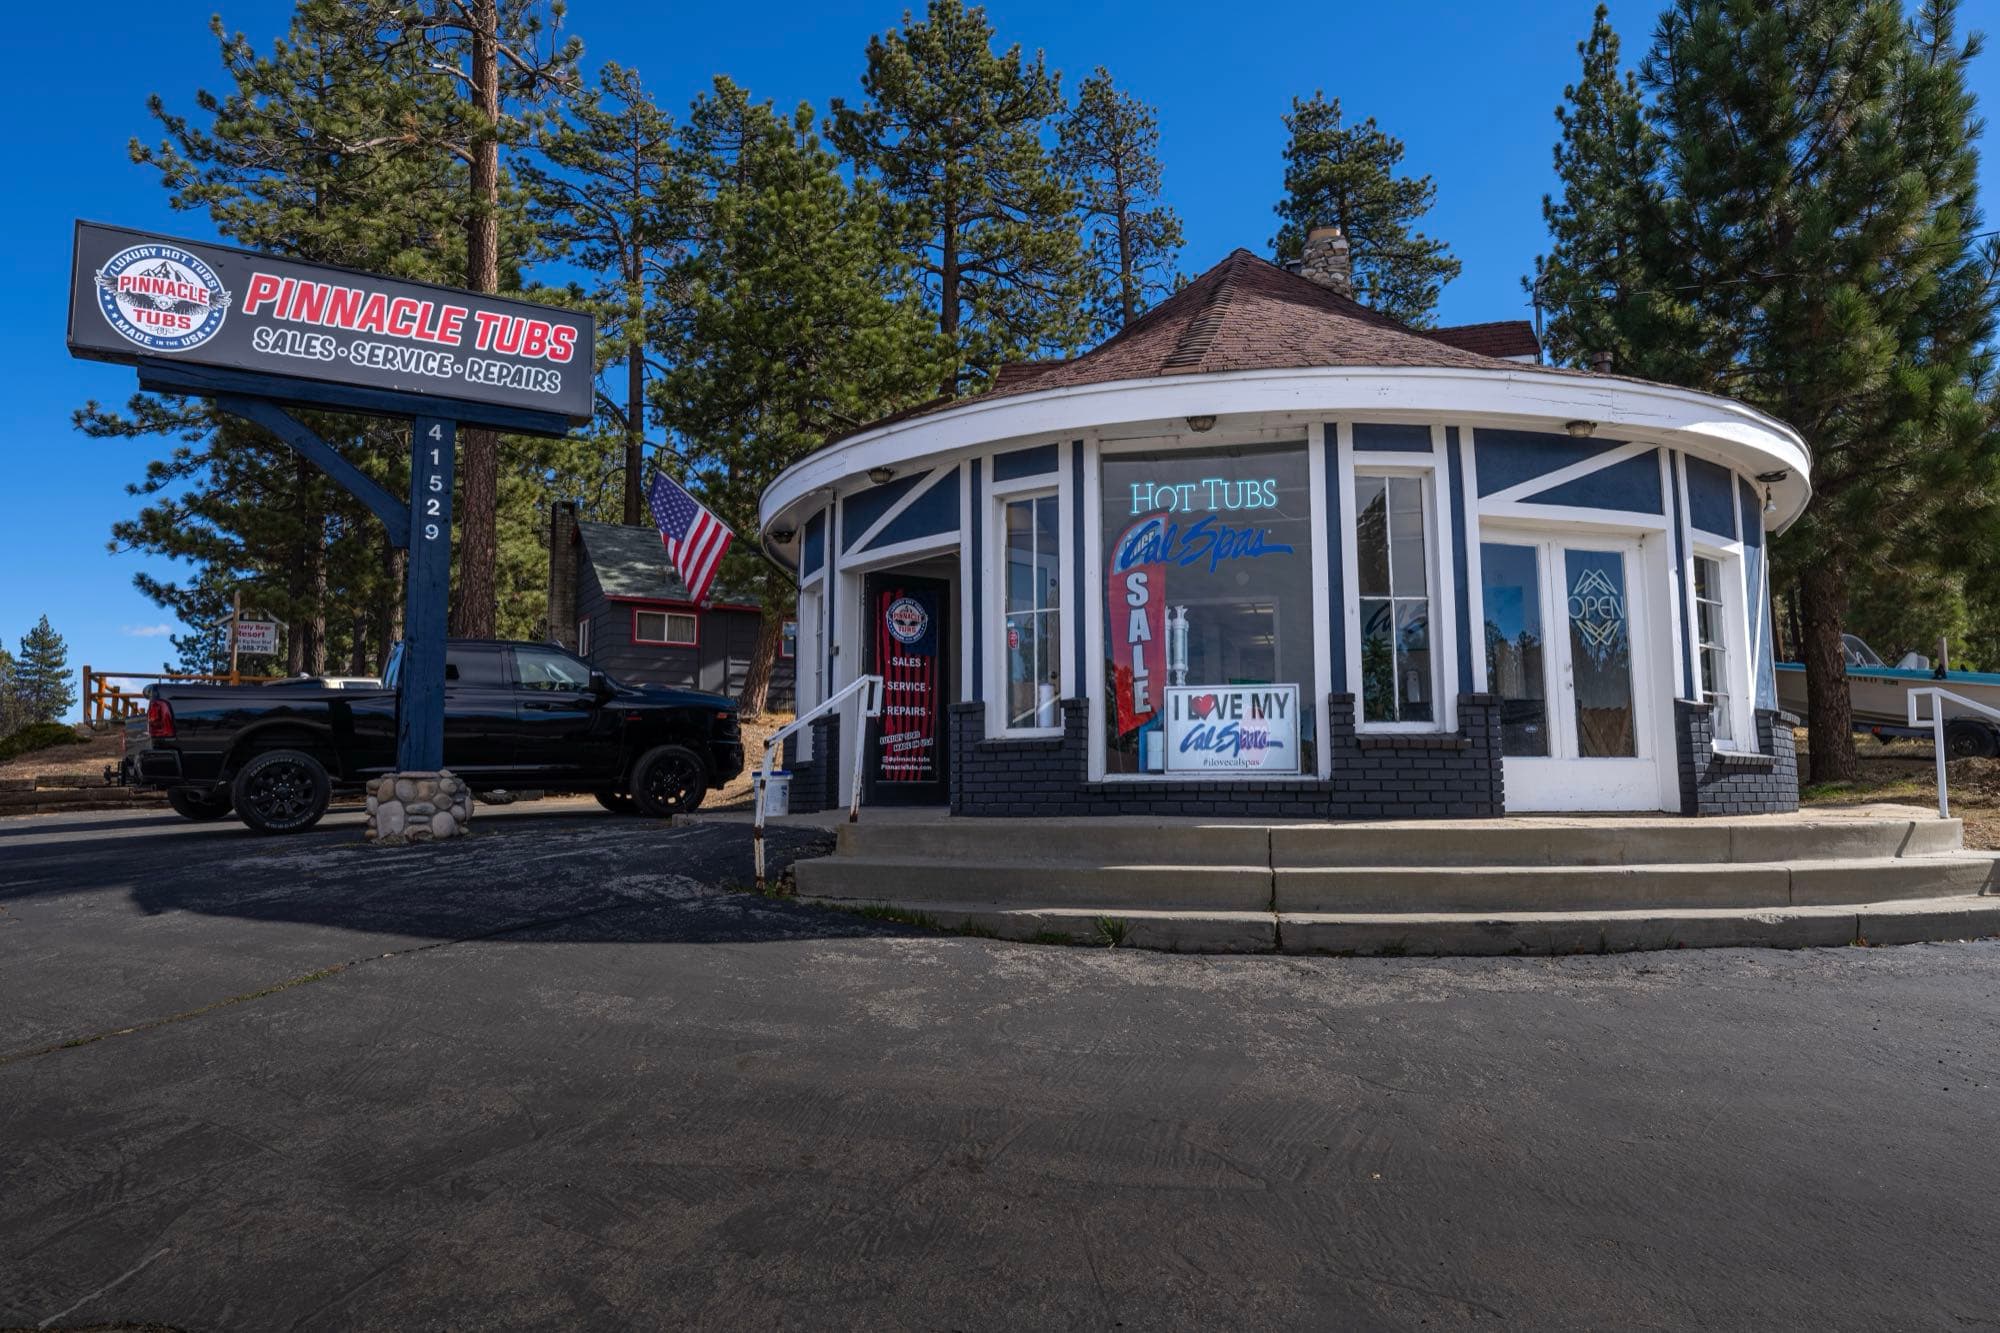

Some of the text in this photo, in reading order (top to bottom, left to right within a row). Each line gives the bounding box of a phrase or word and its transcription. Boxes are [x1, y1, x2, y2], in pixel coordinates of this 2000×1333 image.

[111, 248, 217, 288] LUXURY HOT TUBS
[119, 275, 209, 305] PINNACLE
[116, 319, 153, 345] MADE
[181, 332, 206, 346] USA
[133, 308, 192, 330] TUBS
[242, 272, 578, 363] PINNACLE TUBS
[253, 326, 561, 394] SALES SERVICE REPAIRS
[425, 424, 442, 540] 41529
[1130, 478, 1278, 514] HOT TUBS
[1120, 520, 1182, 570] Cal
[1179, 515, 1294, 576] Spas
[1568, 595, 1625, 619] OPEN
[1126, 572, 1152, 714] SALE
[892, 656, 921, 667] SALES
[887, 681, 926, 692] SERVICE
[887, 705, 926, 716] REPAIRS
[1174, 695, 1179, 720] I
[1251, 692, 1290, 719] MY
[1180, 721, 1284, 758] Cal Spas
[1203, 757, 1260, 768] #ilovecalspas
